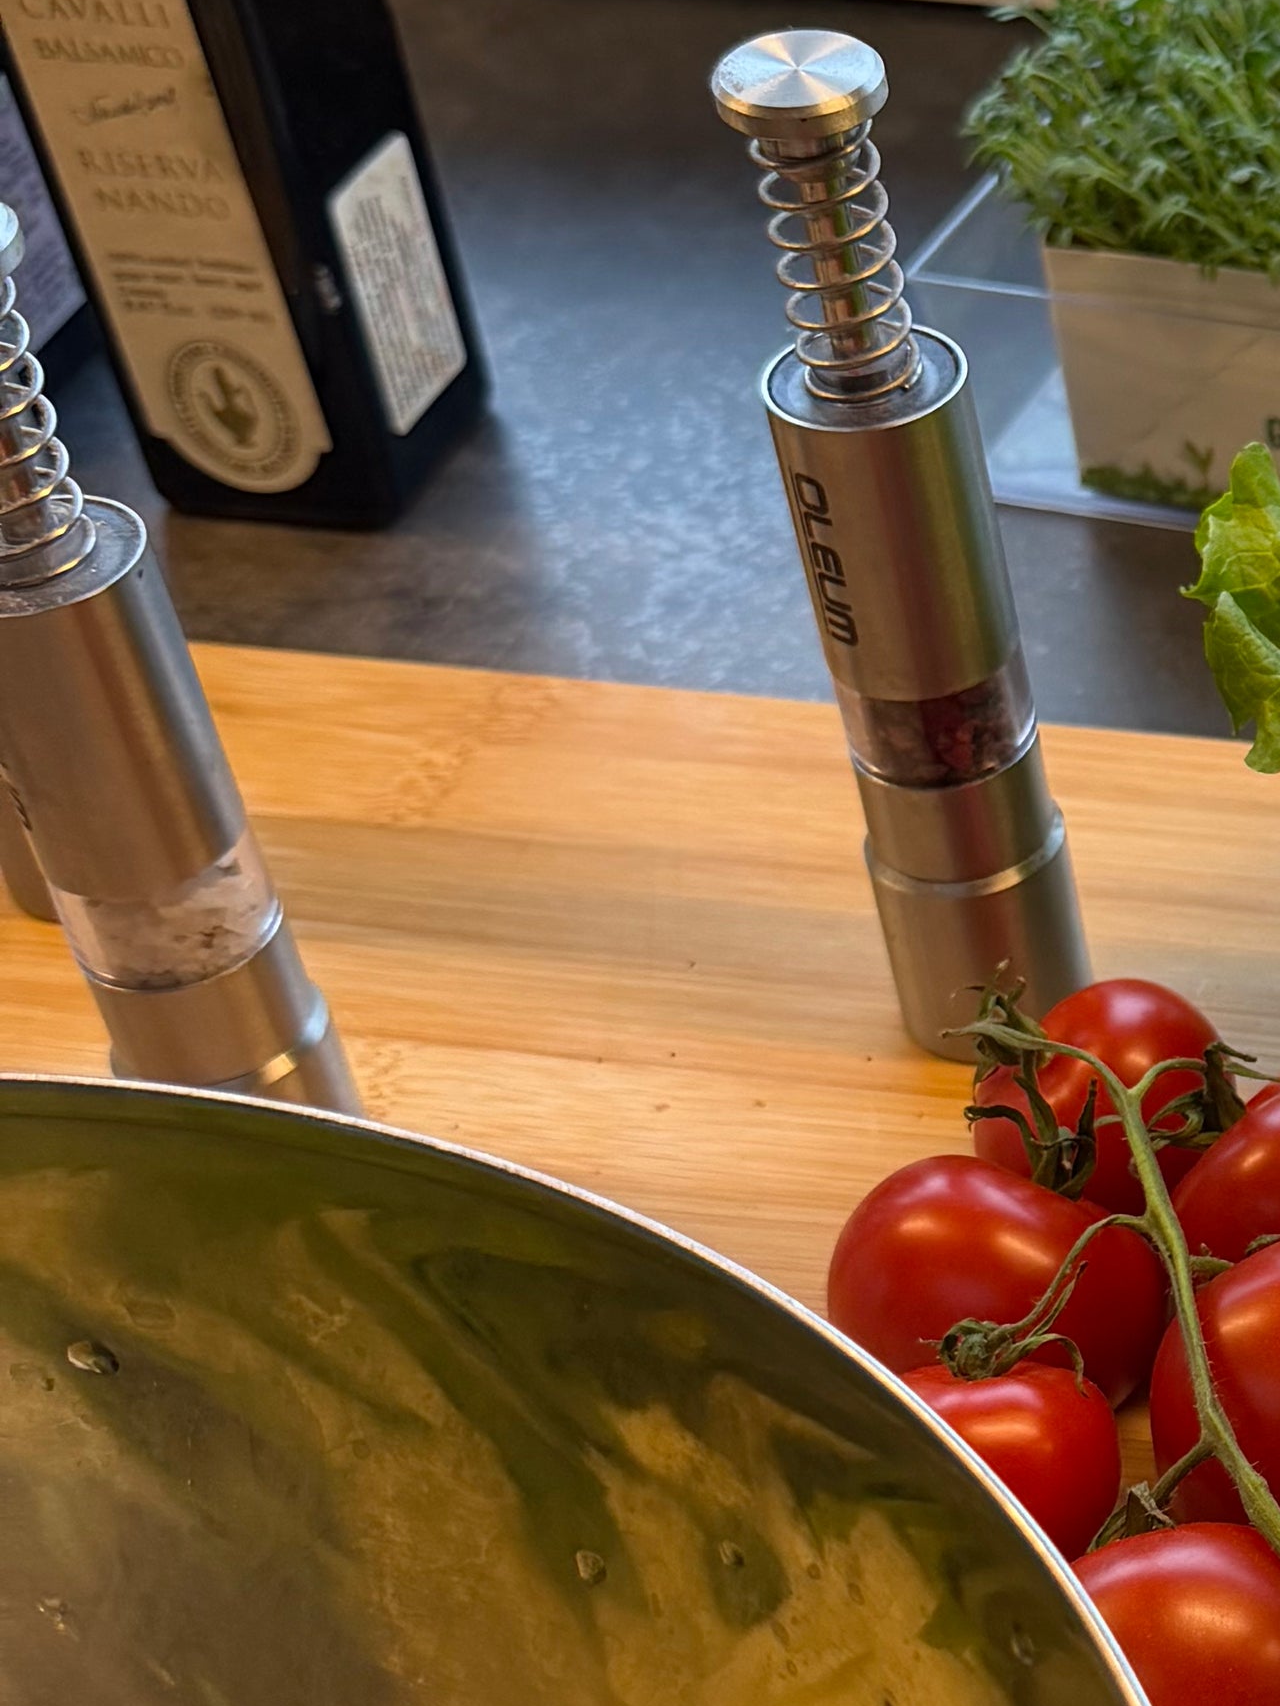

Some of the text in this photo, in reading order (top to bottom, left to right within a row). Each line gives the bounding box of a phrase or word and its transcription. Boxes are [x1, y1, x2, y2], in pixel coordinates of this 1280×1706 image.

[32, 37, 186, 71] BALSAMICO
[78, 148, 225, 185] RISERVA
[795, 472, 858, 646] OLEUM
